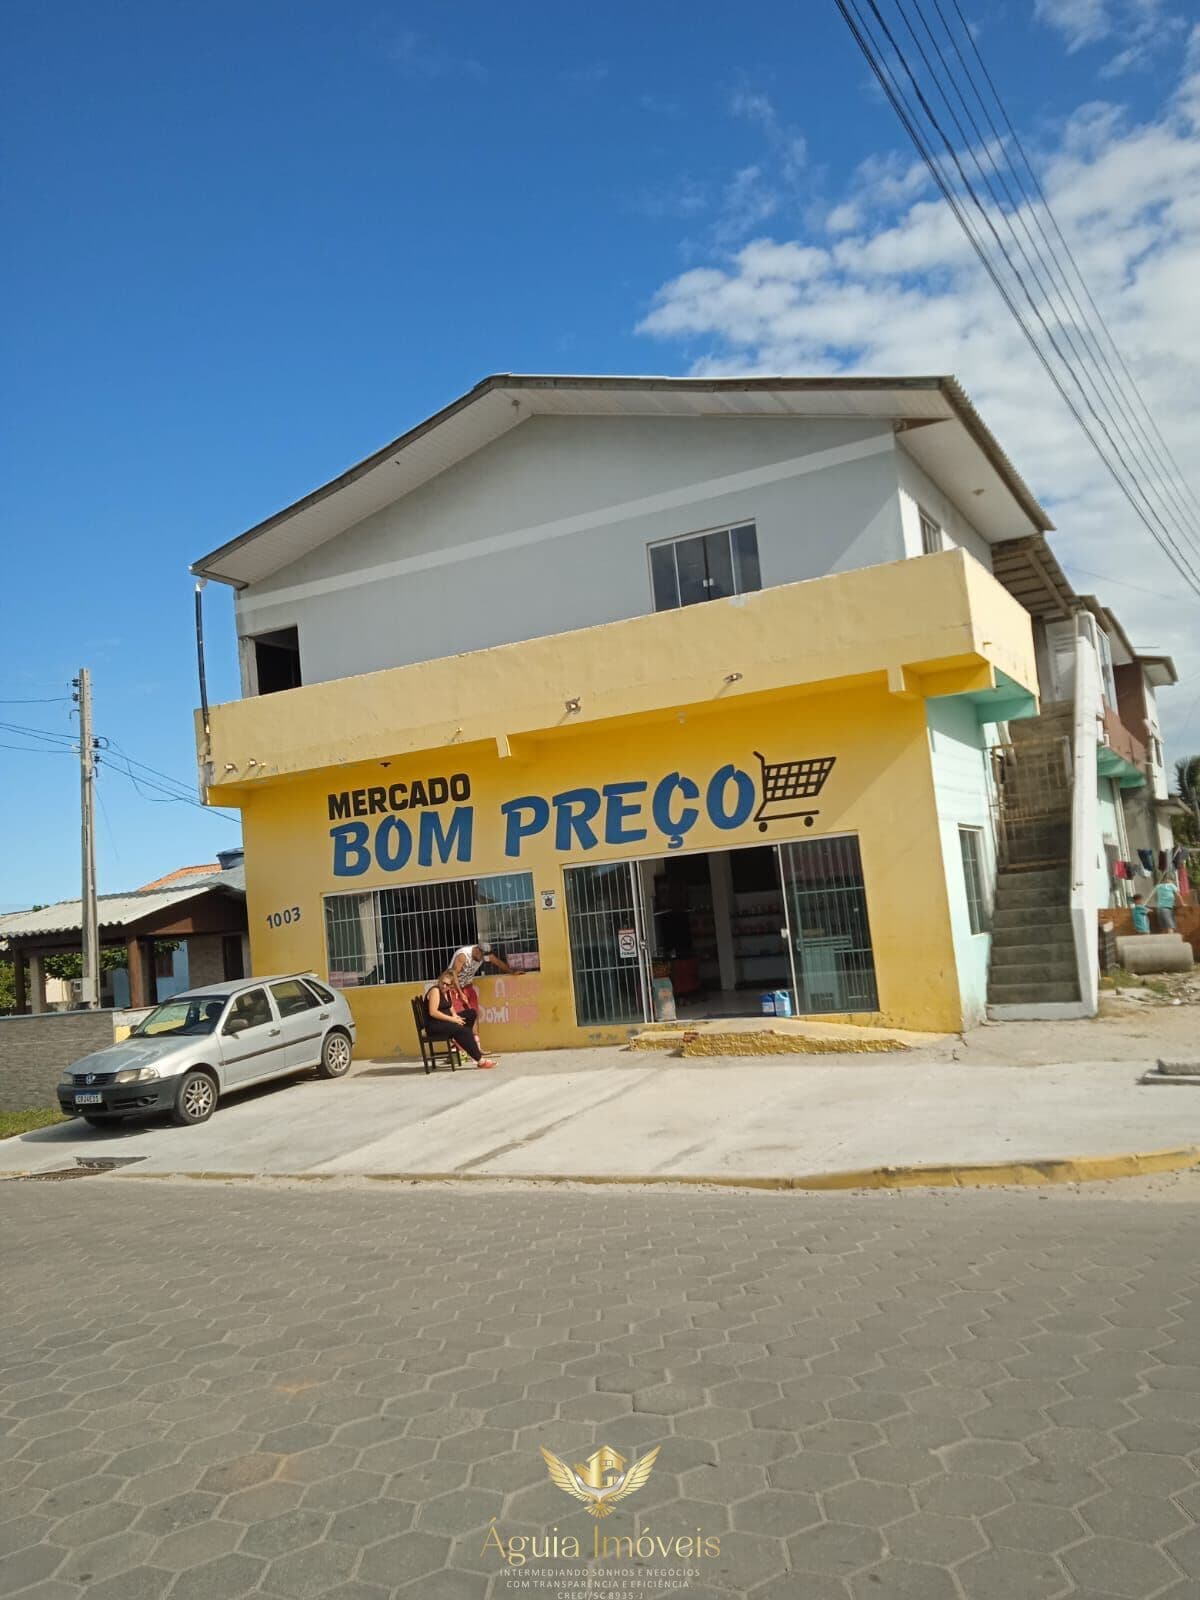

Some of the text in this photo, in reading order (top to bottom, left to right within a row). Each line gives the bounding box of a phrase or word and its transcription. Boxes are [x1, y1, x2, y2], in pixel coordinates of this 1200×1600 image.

[328, 773, 471, 820] MERCADO
[329, 764, 756, 877] BOM PREÇO
[266, 906, 301, 929] 1003
